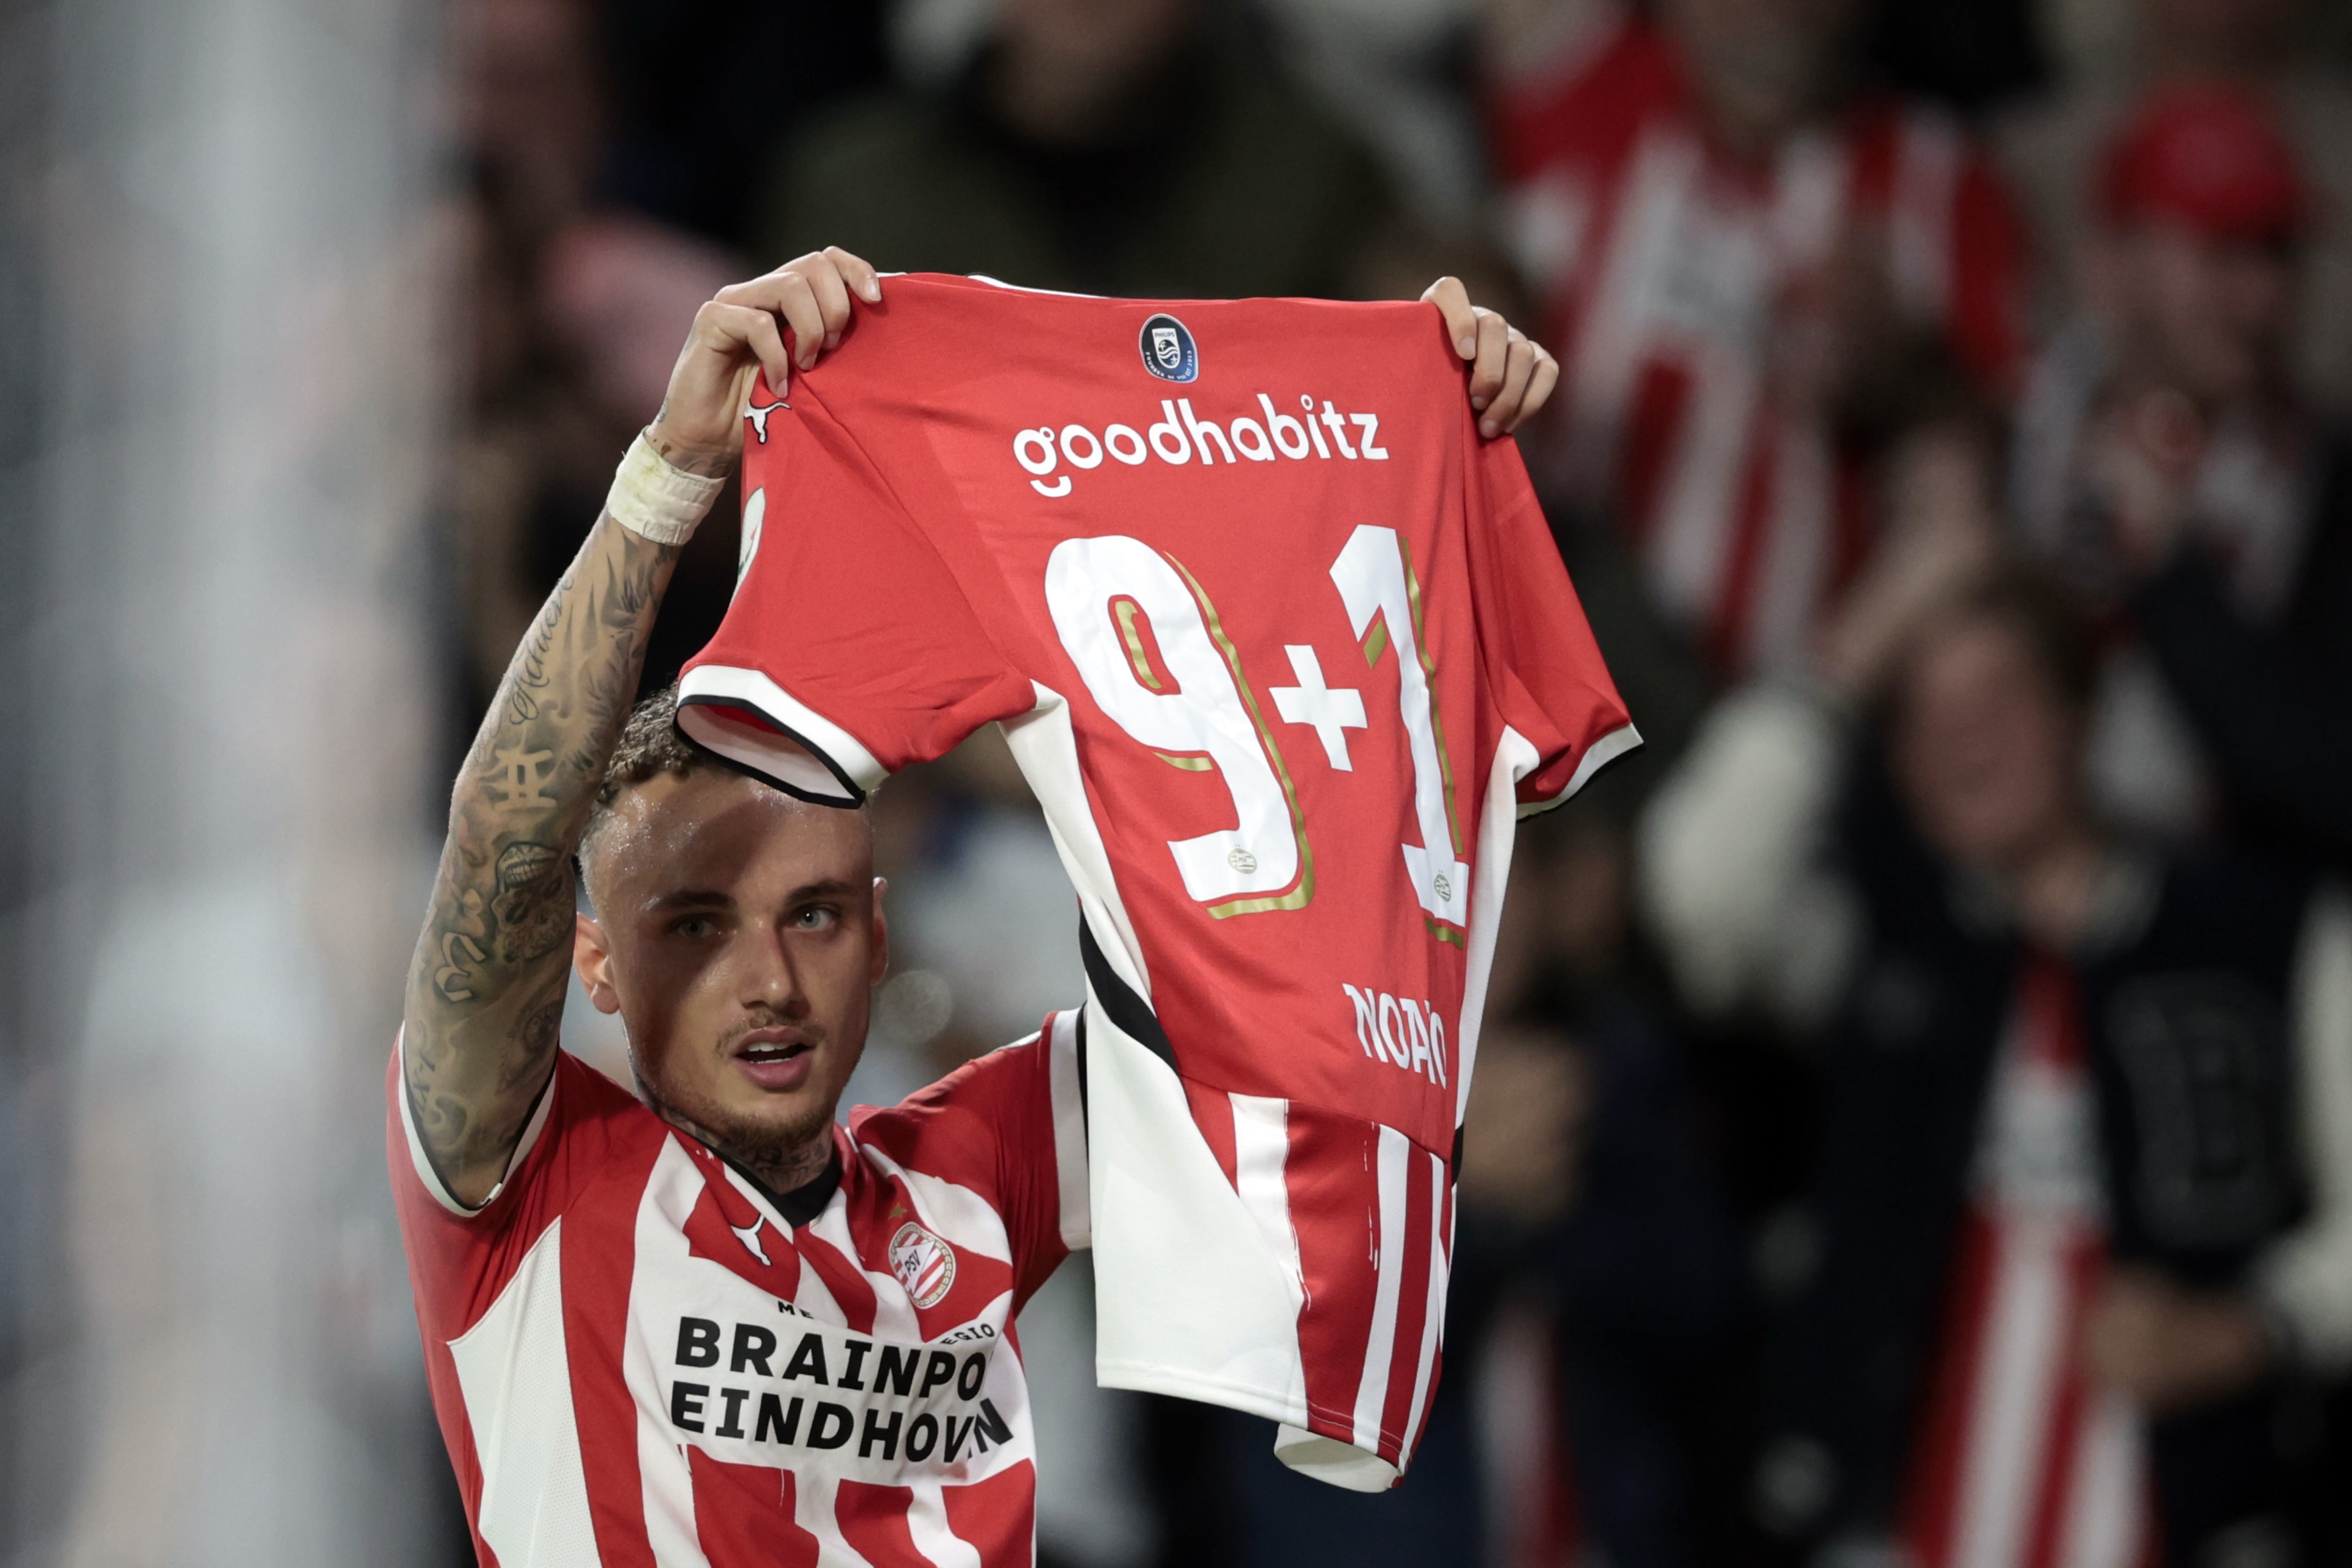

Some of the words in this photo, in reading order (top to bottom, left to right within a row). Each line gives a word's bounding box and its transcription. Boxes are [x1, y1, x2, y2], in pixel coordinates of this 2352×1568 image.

[1145, 352, 1164, 377] FOUNDER
[1013, 393, 1390, 498] goodhabitz
[905, 1249, 920, 1276] PSV
[675, 1316, 988, 1401] BRAINPO
[940, 1323, 995, 1345] EGIO
[671, 1381, 1014, 1463] EINDHOVN
